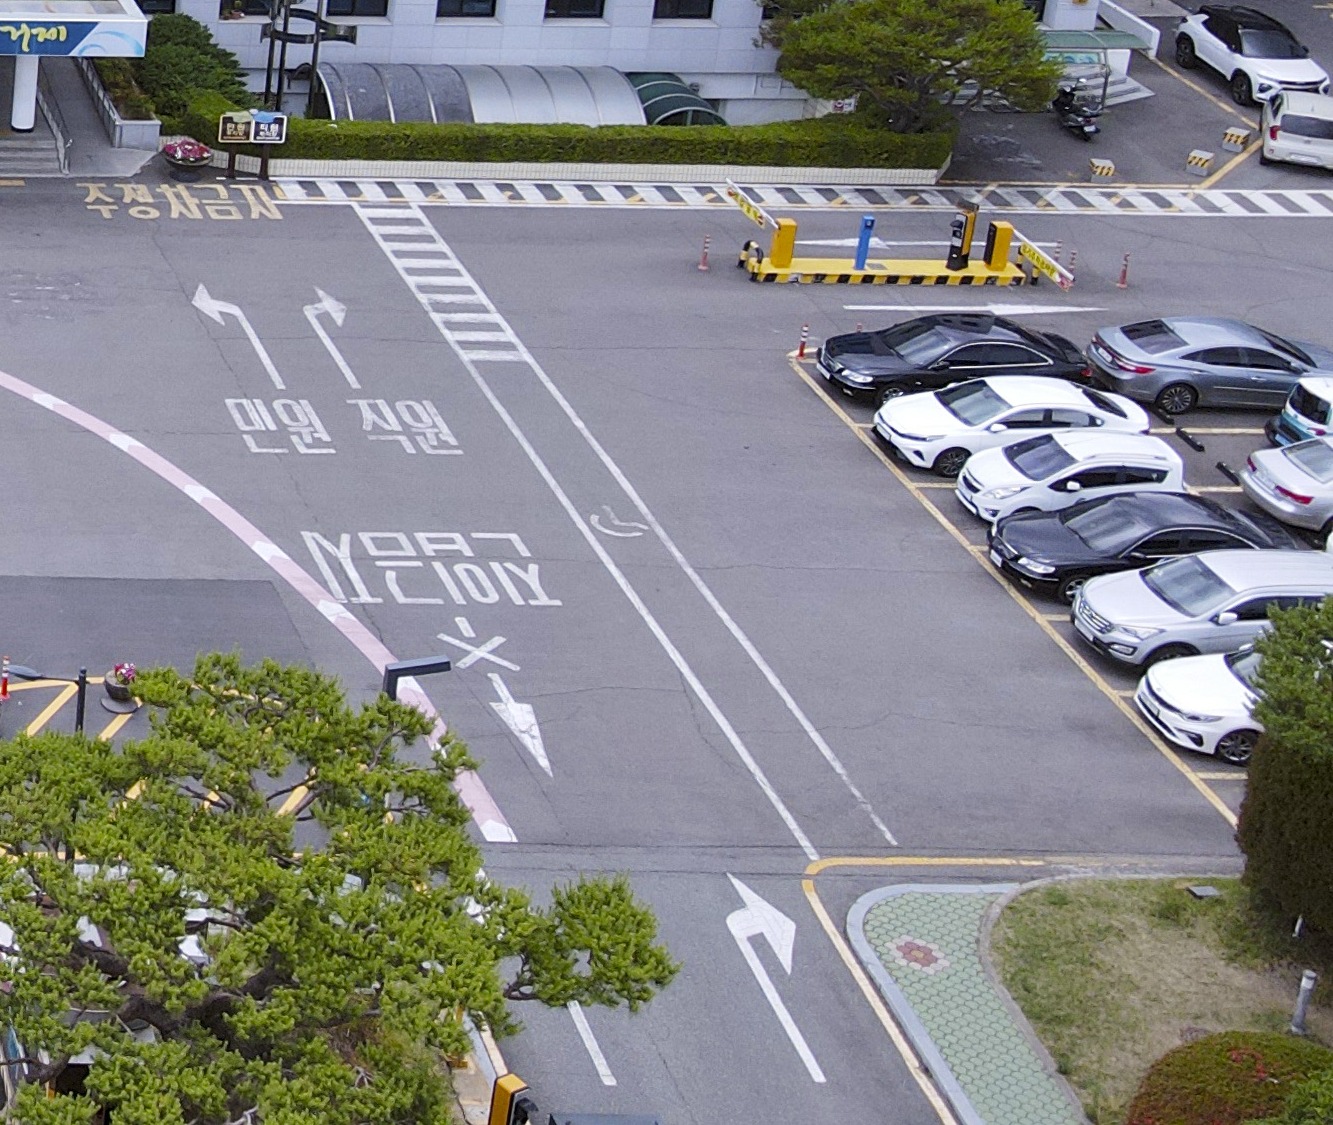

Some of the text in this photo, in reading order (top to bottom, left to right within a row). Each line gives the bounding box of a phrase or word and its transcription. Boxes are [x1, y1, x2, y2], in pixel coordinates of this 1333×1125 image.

[75, 182, 284, 221] 주정차금지
[224, 398, 464, 456] 민원 직원
[300, 530, 564, 607] 진입금지
